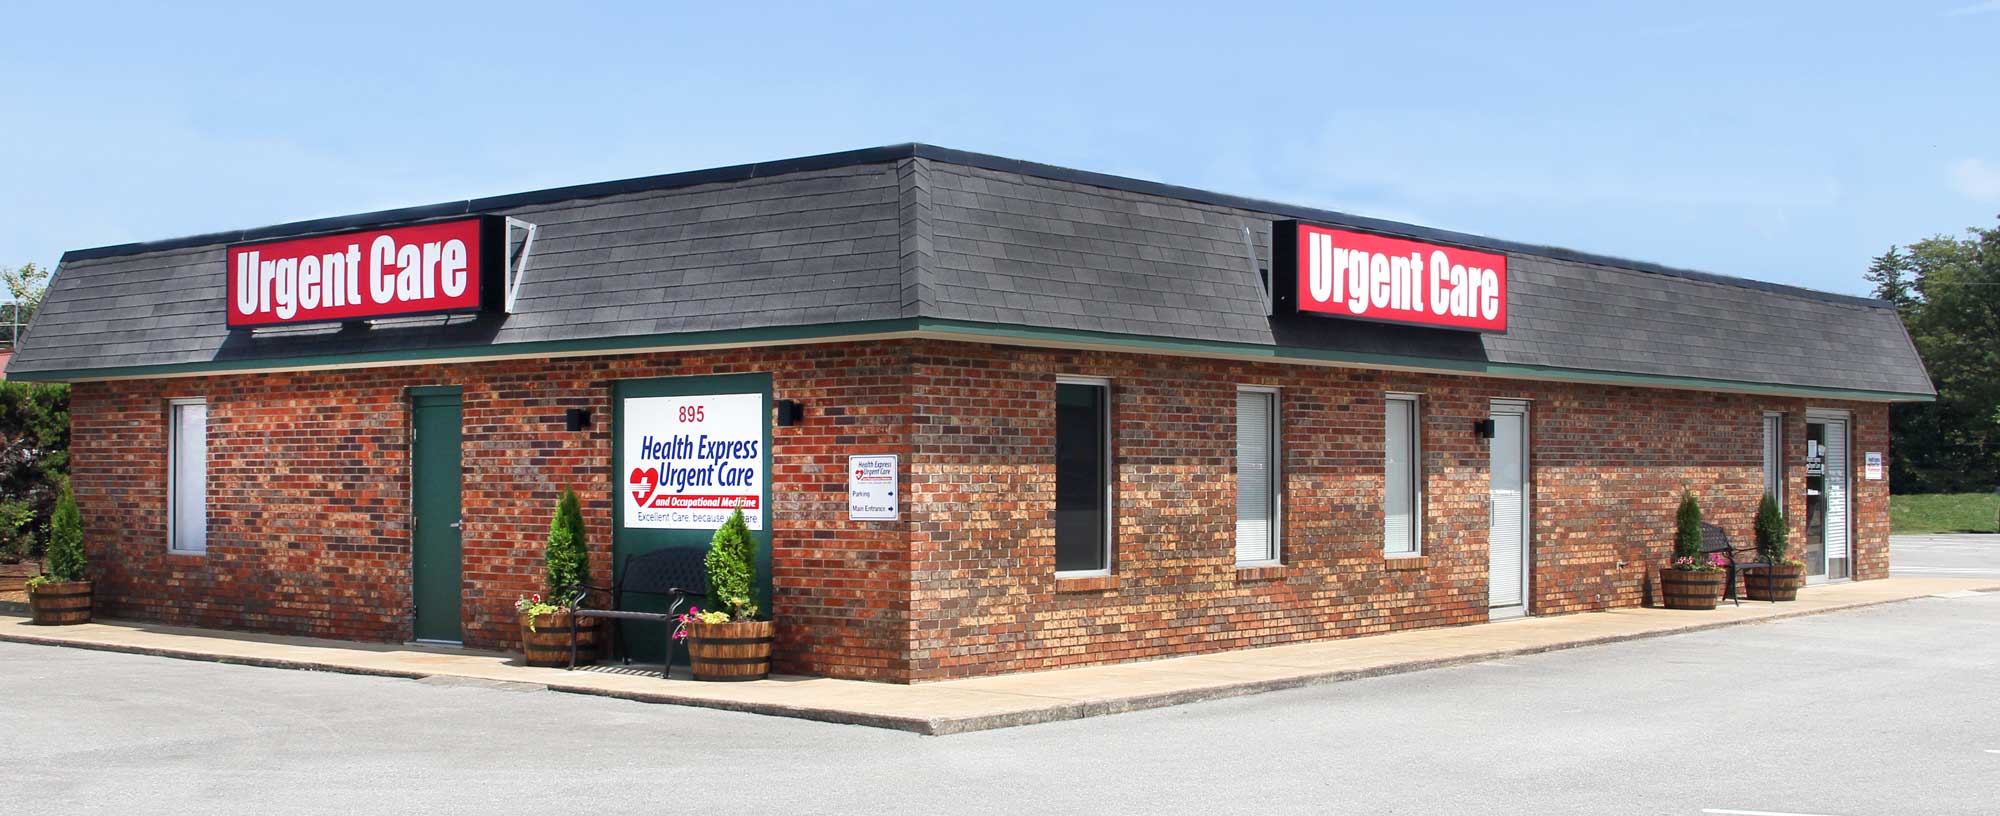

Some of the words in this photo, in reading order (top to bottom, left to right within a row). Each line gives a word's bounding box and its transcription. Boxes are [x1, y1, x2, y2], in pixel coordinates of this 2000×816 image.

[237, 244, 362, 320] Urgent
[369, 234, 468, 304] Care
[1309, 231, 1424, 315] Urgent
[1429, 249, 1499, 321] Care
[678, 405, 705, 423] 895
[641, 434, 694, 460] Health
[697, 434, 759, 466] Express
[659, 461, 715, 493] Urgent
[717, 460, 754, 487] Care
[874, 460, 892, 469] Express
[655, 497, 670, 507] and
[671, 496, 721, 509] Occupational
[721, 497, 756, 508] Medicine
[637, 511, 670, 522] Excellent
[692, 512, 725, 523] because
[741, 514, 758, 524] are
